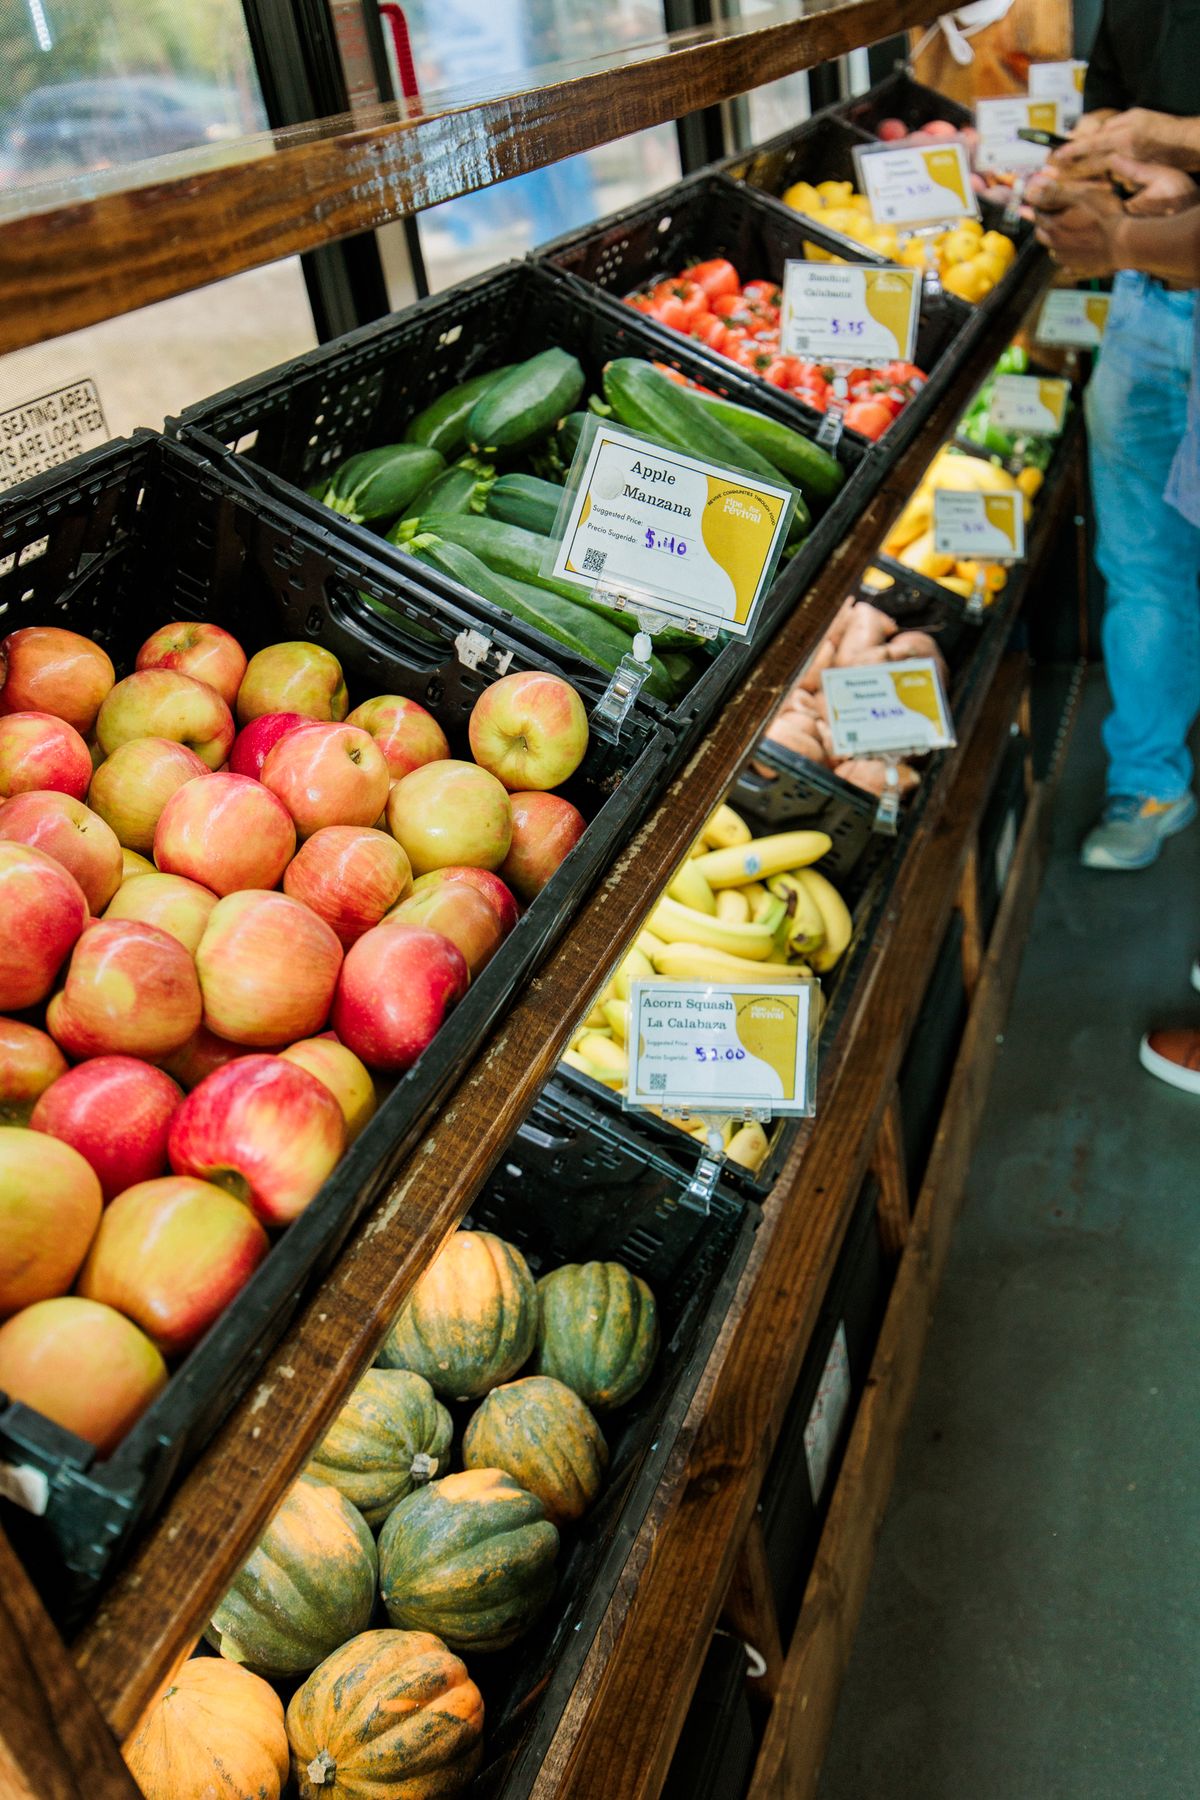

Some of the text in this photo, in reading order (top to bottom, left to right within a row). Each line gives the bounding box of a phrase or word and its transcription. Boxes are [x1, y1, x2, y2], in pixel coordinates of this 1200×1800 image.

[2, 400, 58, 440] SEATING
[19, 434, 45, 461] ARE
[45, 409, 103, 451] LOCATED
[630, 461, 676, 485] Apple
[622, 484, 692, 518] Manzana
[726, 497, 743, 509] ripe
[592, 505, 643, 527] Suggested Price:
[723, 504, 761, 524] revival
[587, 522, 607, 535] Precio
[643, 998, 682, 1009] Acorn
[686, 999, 733, 1012] Squash
[647, 1018, 727, 1030] La Calabaza
[695, 1047, 745, 1062] $2.00
